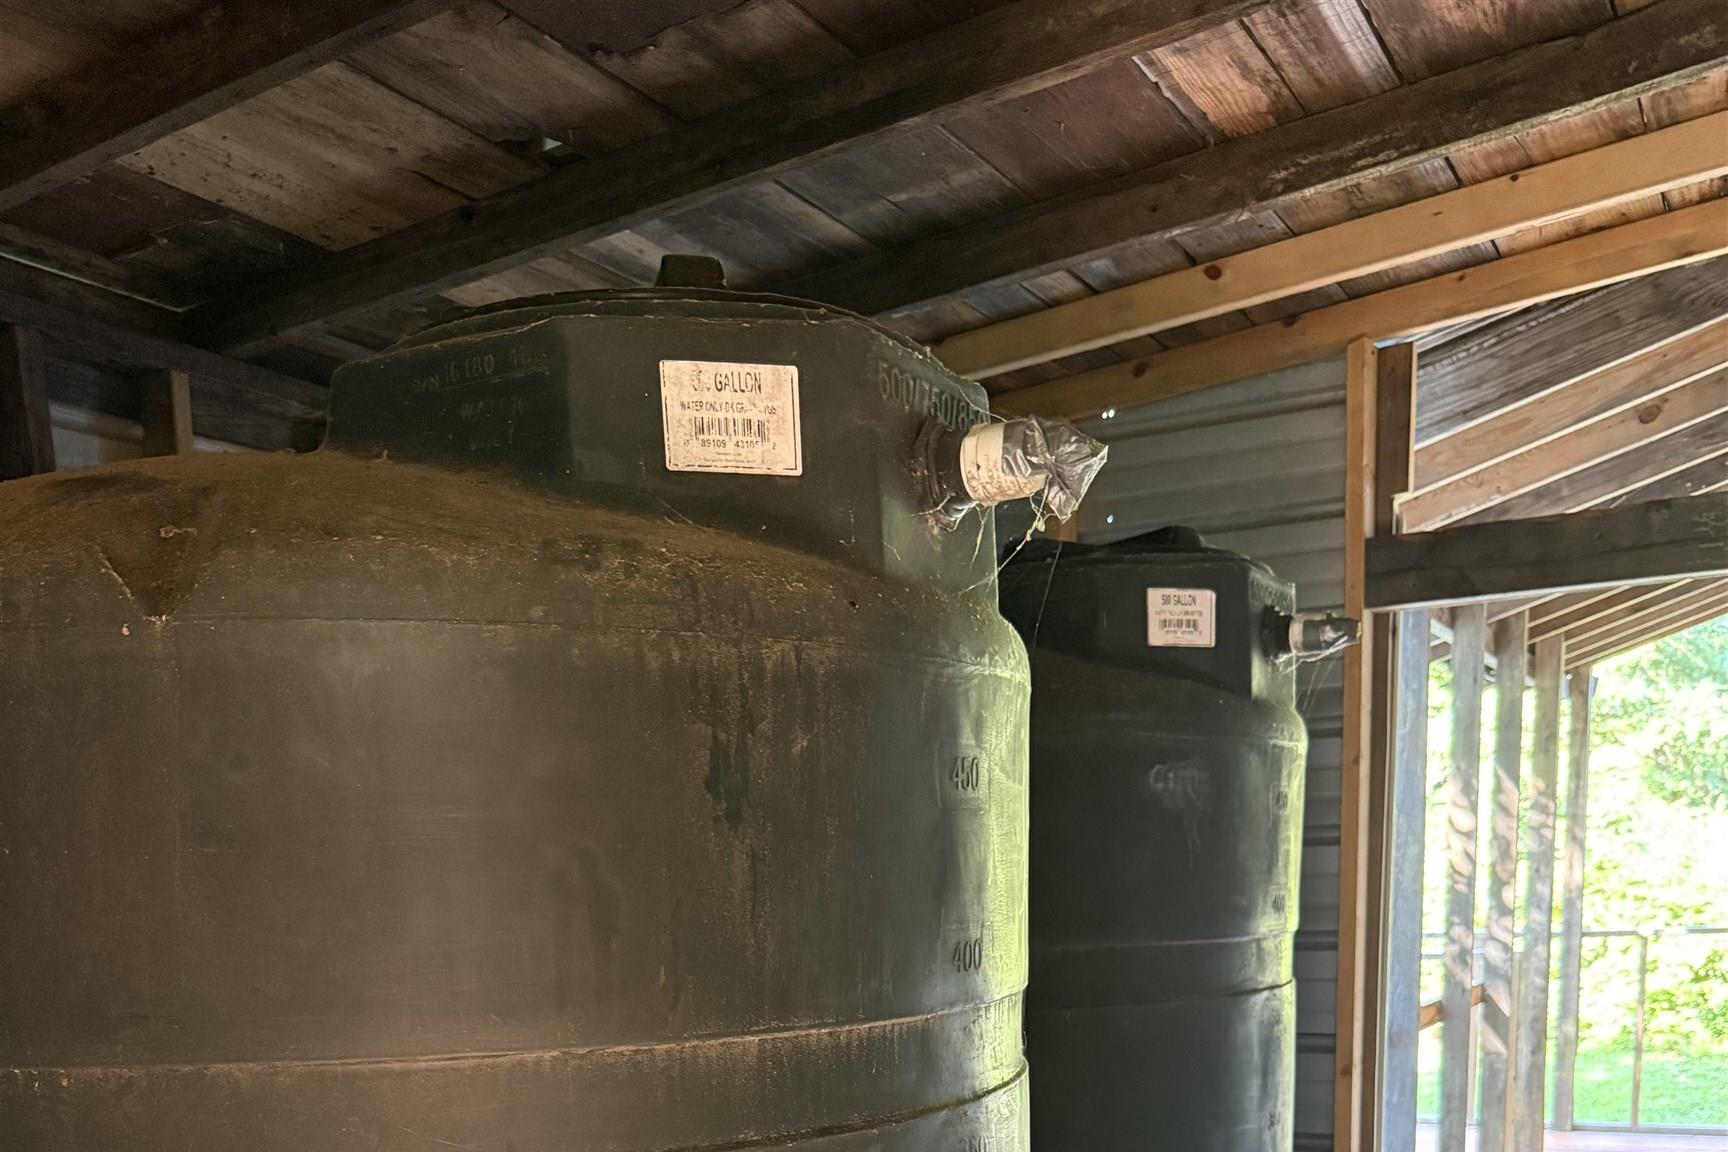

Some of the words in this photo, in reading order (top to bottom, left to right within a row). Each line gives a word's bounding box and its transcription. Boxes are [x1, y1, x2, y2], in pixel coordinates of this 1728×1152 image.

[714, 371, 762, 394] GALLON
[680, 401, 703, 412] WATER
[701, 439, 726, 448] 89109
[952, 755, 980, 792] 450
[953, 940, 983, 974] 400
